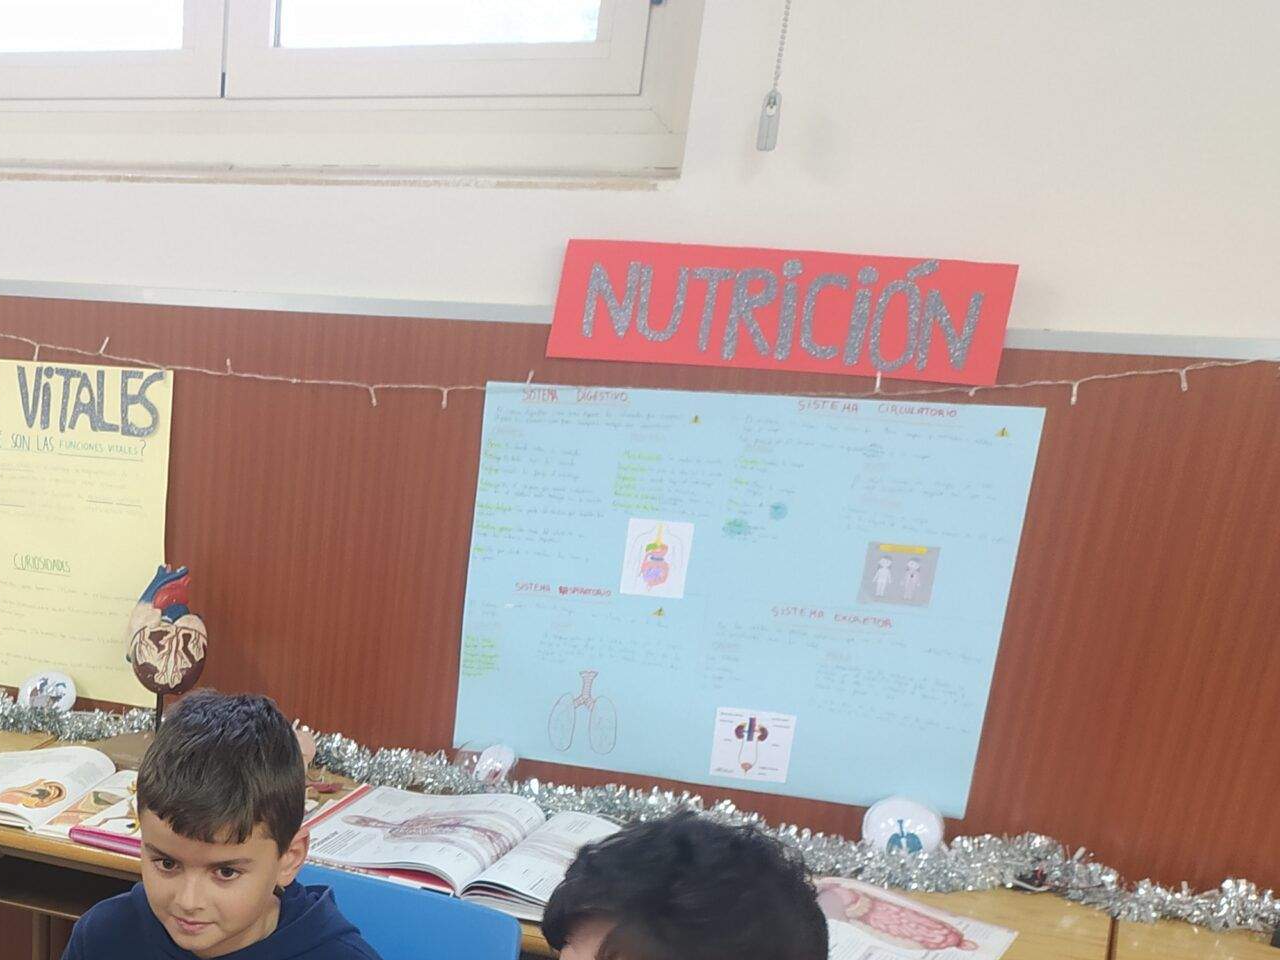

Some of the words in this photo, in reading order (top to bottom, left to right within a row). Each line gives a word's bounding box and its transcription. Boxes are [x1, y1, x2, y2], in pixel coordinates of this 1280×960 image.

[878, 403, 957, 417] CIRCULATORIO
[11, 433, 30, 450] SON
[37, 435, 54, 451] LAS
[59, 438, 104, 451] FUNCIONES
